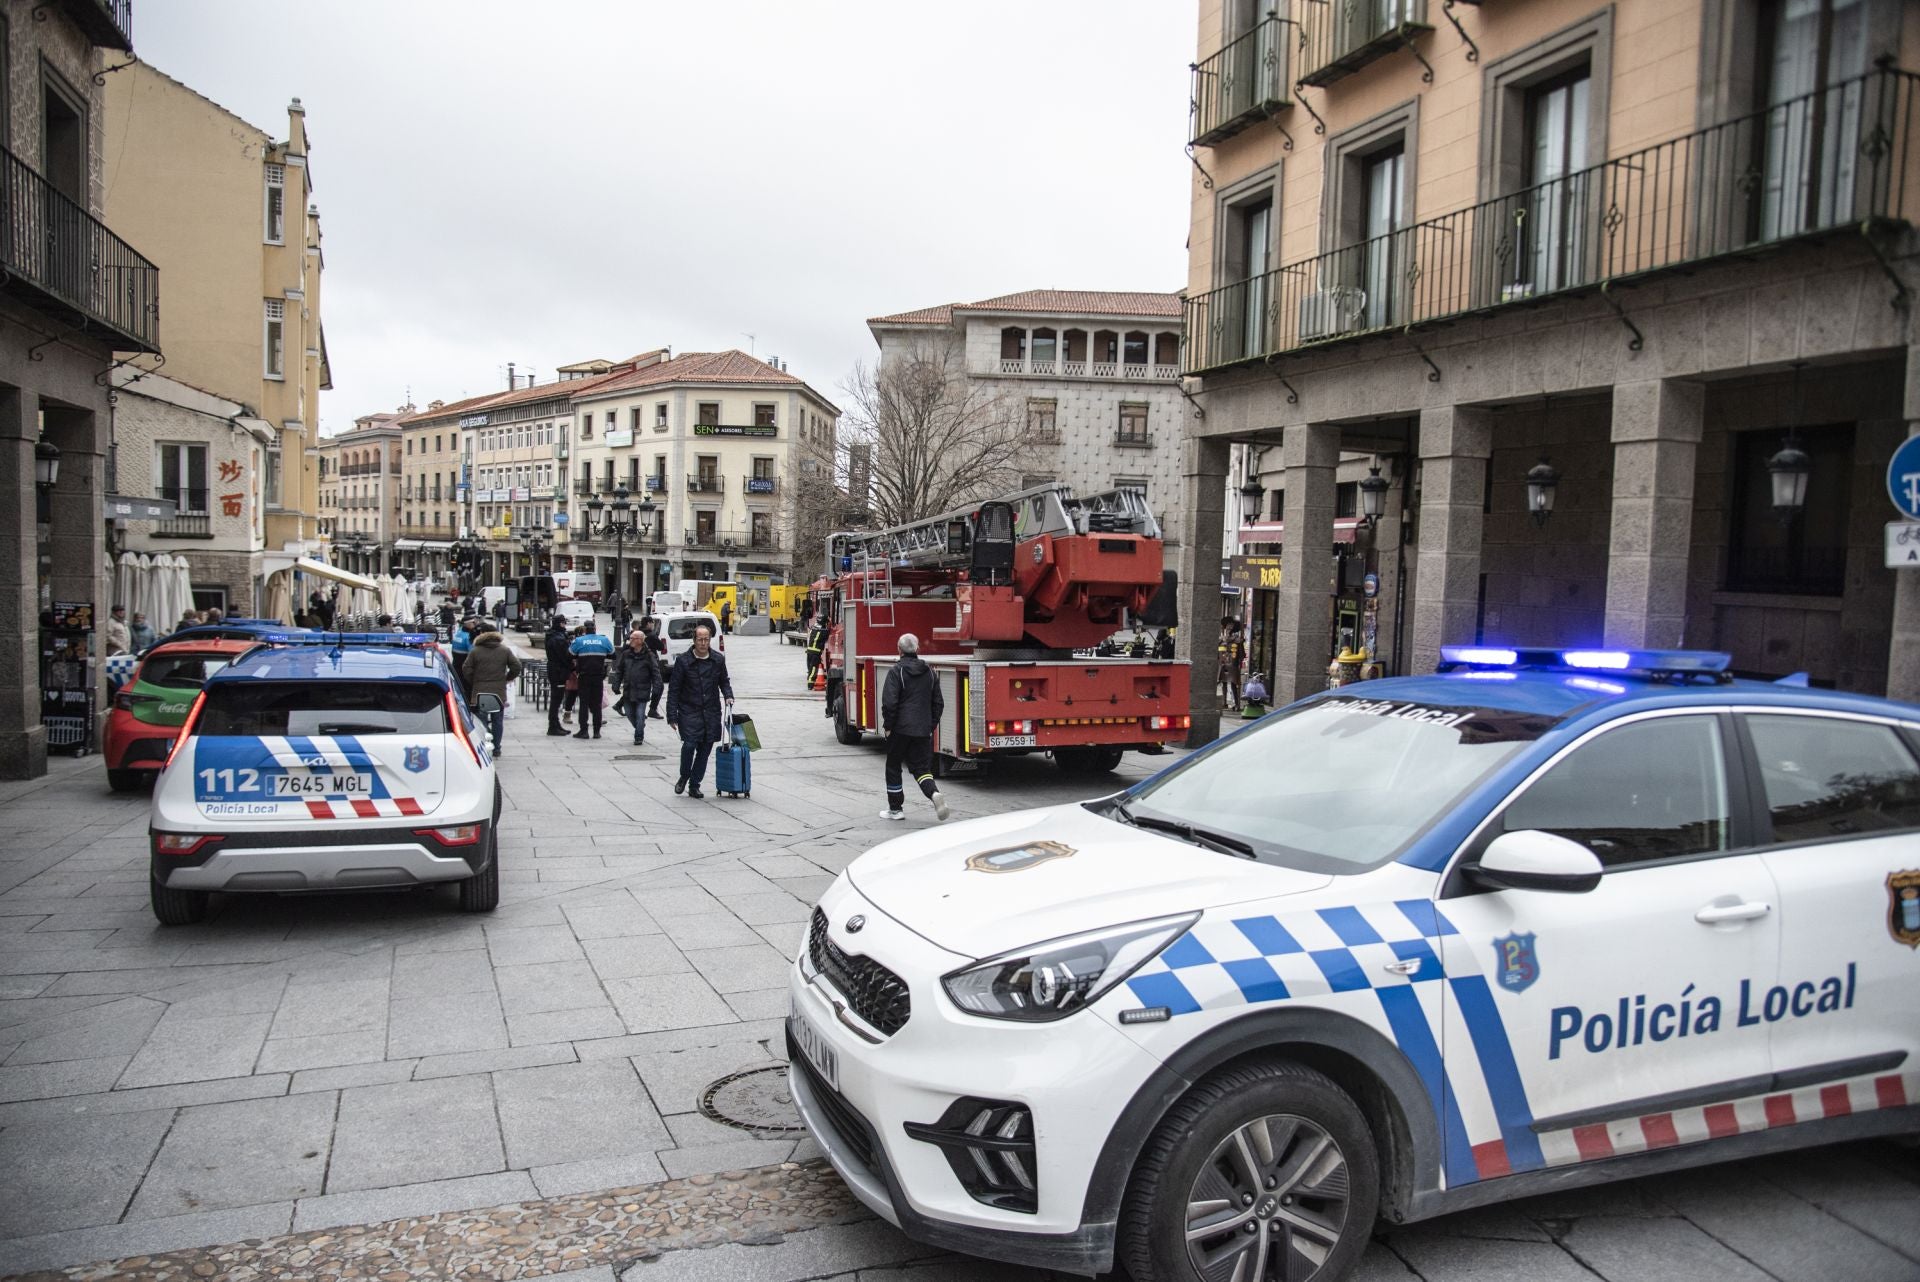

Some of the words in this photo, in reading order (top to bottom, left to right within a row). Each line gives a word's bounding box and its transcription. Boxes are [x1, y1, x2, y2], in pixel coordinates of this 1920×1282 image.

[696, 425, 714, 434] SEN
[1321, 699, 1393, 716] Policía
[1387, 703, 1476, 728] Local
[199, 768, 260, 793] 112
[279, 776, 325, 793] 7645
[333, 776, 368, 792] MGL
[205, 803, 244, 814] Policía
[248, 803, 278, 814] Local
[1548, 982, 1722, 1061] Policía
[1736, 961, 1857, 1028] Local
[1258, 1198, 1276, 1217] KIA
